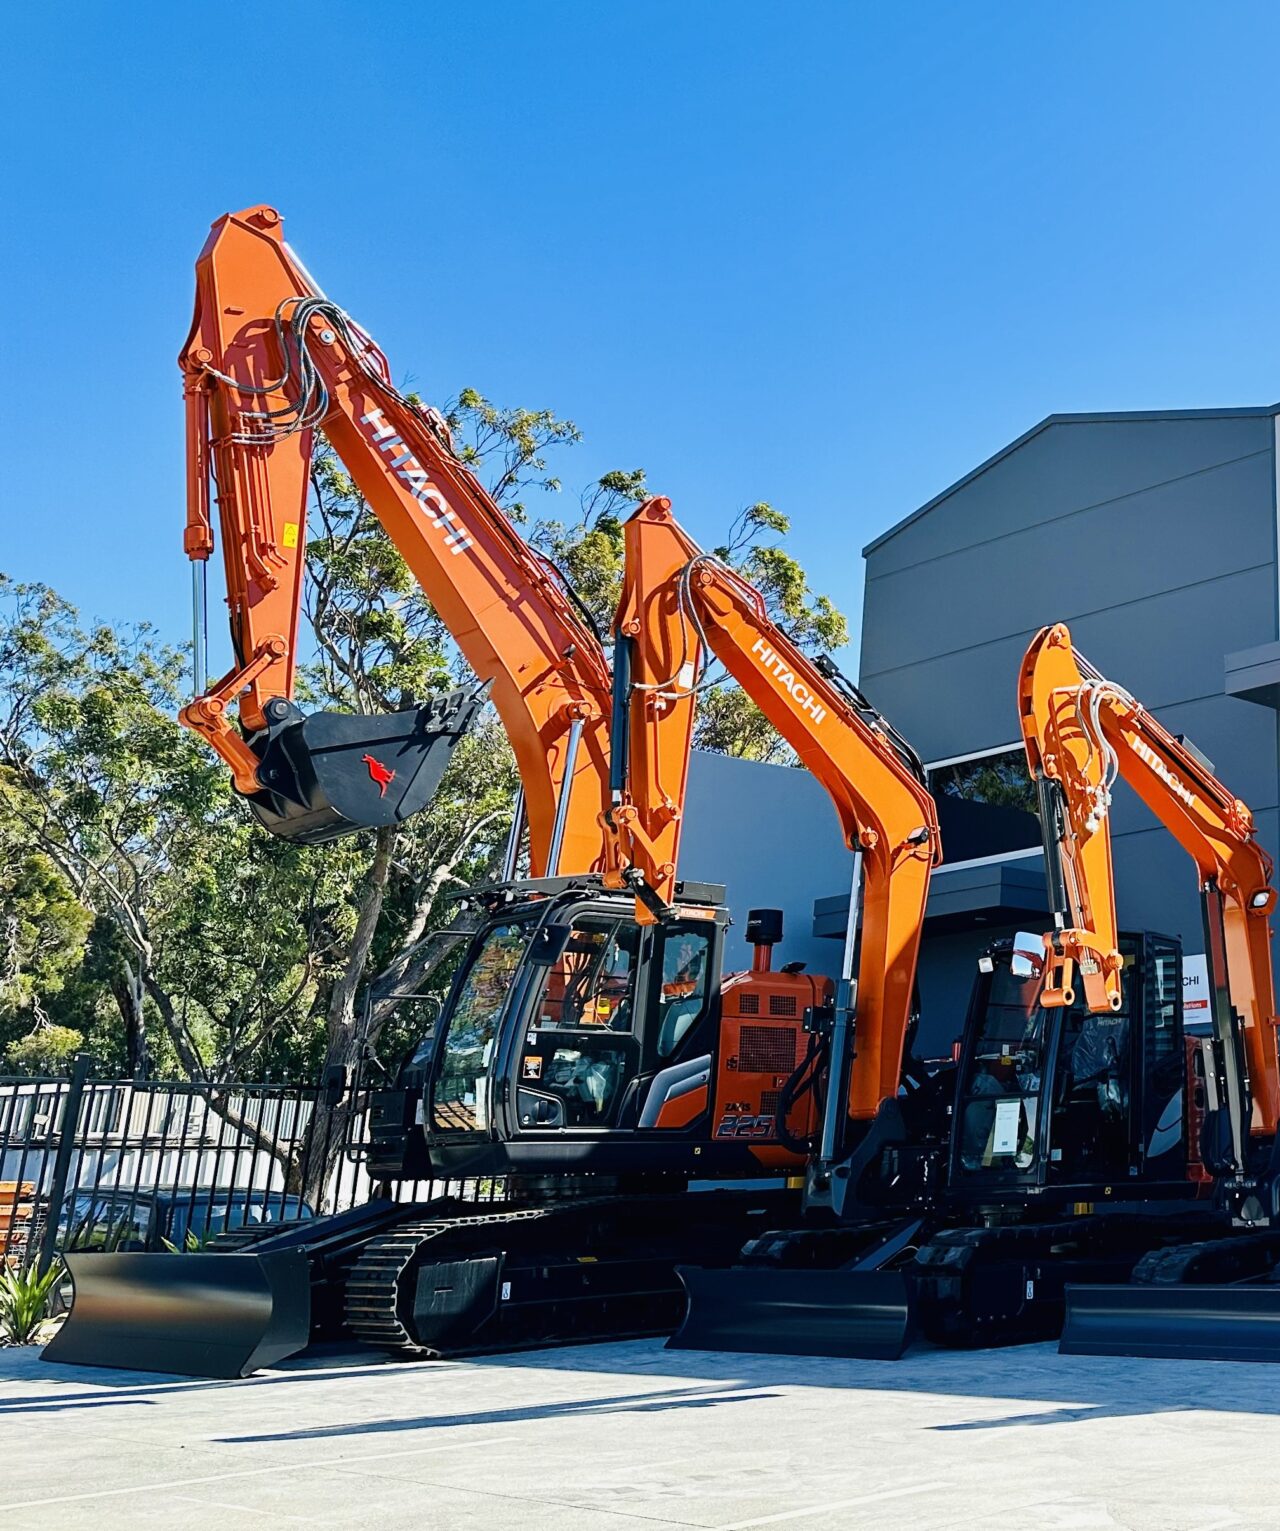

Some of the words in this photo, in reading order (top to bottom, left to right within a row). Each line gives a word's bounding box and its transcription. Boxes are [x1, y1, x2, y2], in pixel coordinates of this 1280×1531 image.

[360, 407, 474, 556] HITACHI
[751, 637, 827, 725] HITACHI
[1132, 735, 1195, 807] HITACHI
[716, 1114, 774, 1138] 225
